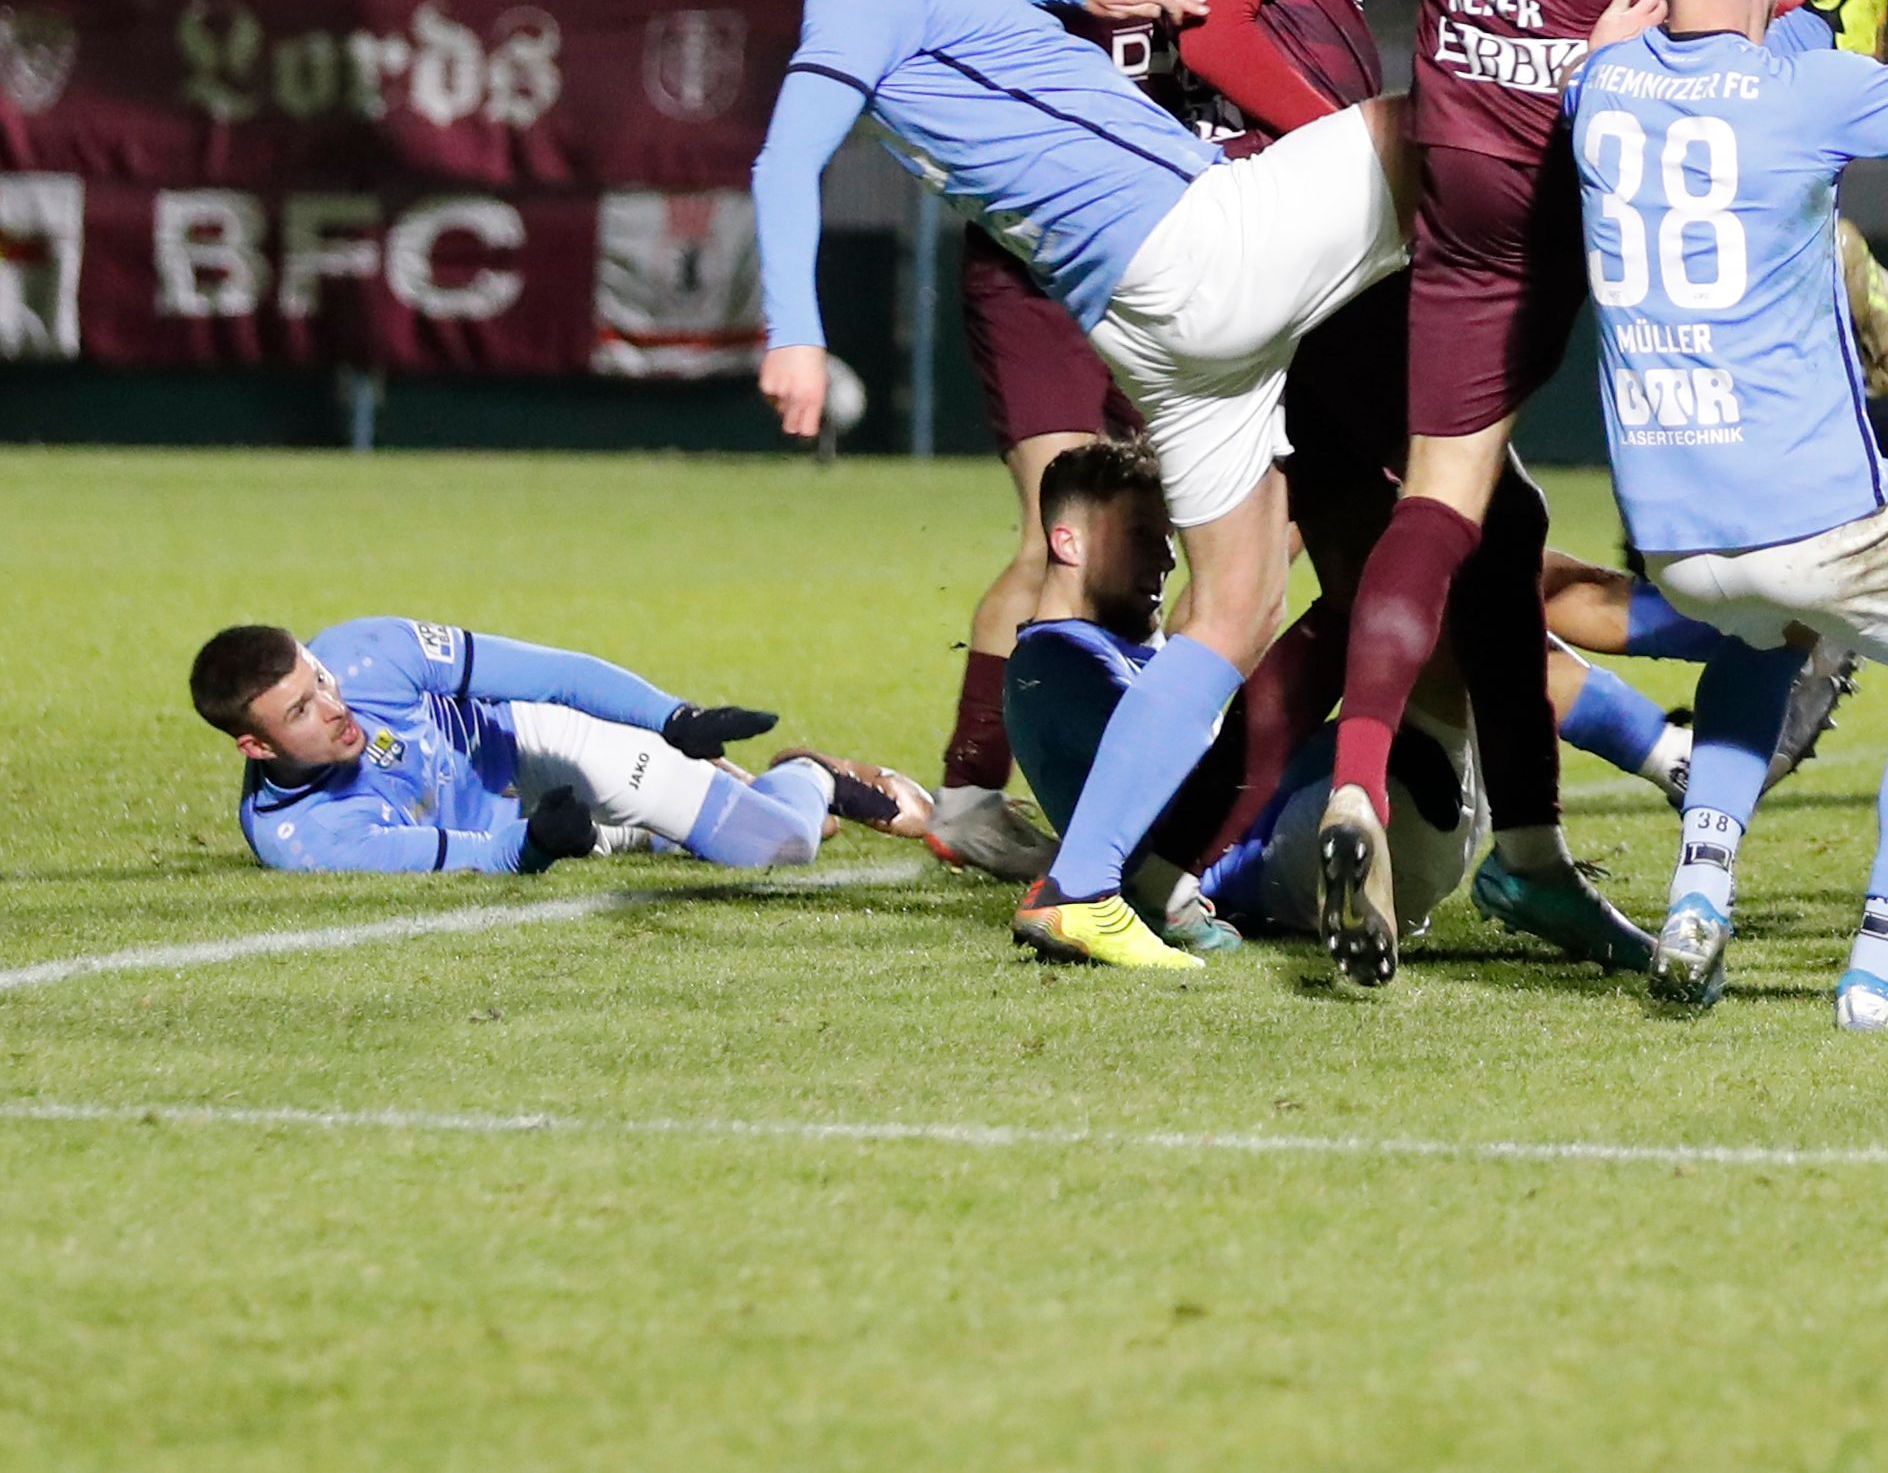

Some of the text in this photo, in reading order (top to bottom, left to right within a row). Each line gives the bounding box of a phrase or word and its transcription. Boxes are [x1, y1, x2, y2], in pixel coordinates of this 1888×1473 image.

[1723, 71, 1760, 100] FC
[1583, 110, 1748, 309] 38
[153, 189, 528, 322] BFC
[1615, 318, 1713, 354] MÜLLER
[1621, 427, 1744, 446] LASERTECHNIK
[629, 752, 649, 790] JAKO
